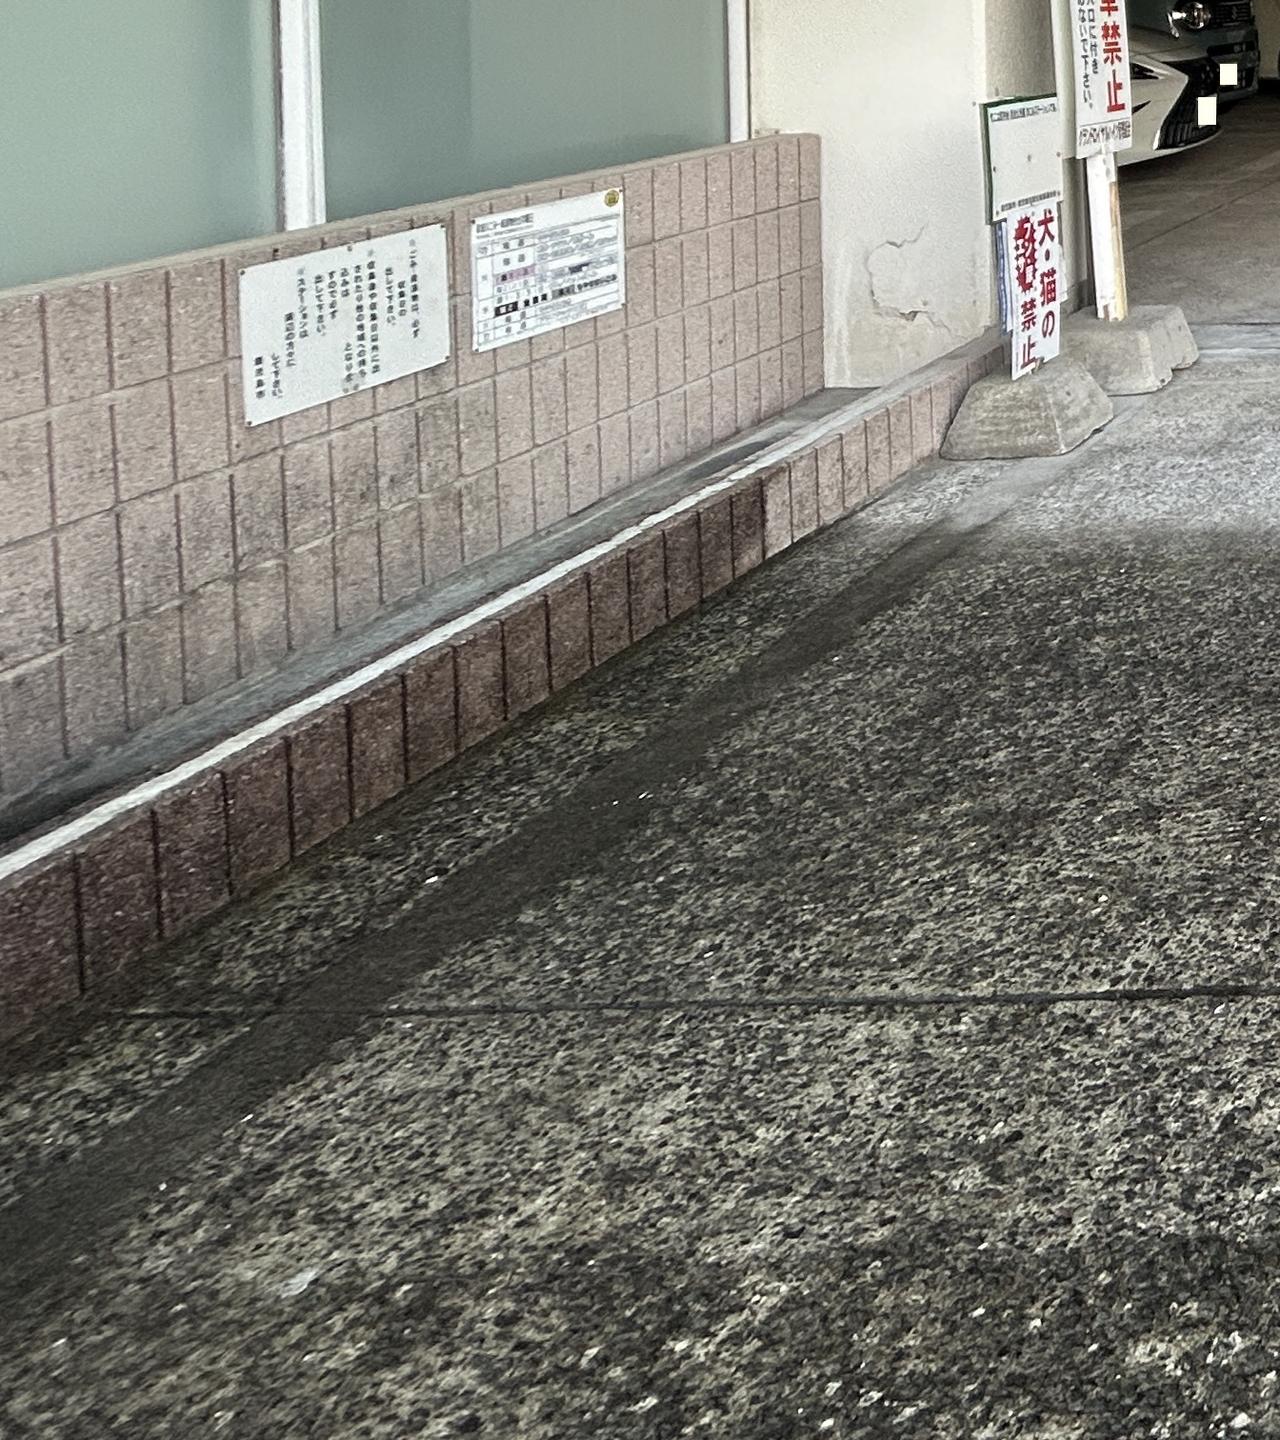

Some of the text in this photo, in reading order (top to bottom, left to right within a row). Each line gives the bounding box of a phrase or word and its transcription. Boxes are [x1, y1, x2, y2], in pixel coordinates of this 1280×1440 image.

[1037, 208, 1057, 338] 犬・猫の
[1021, 298, 1038, 369] 禁止
